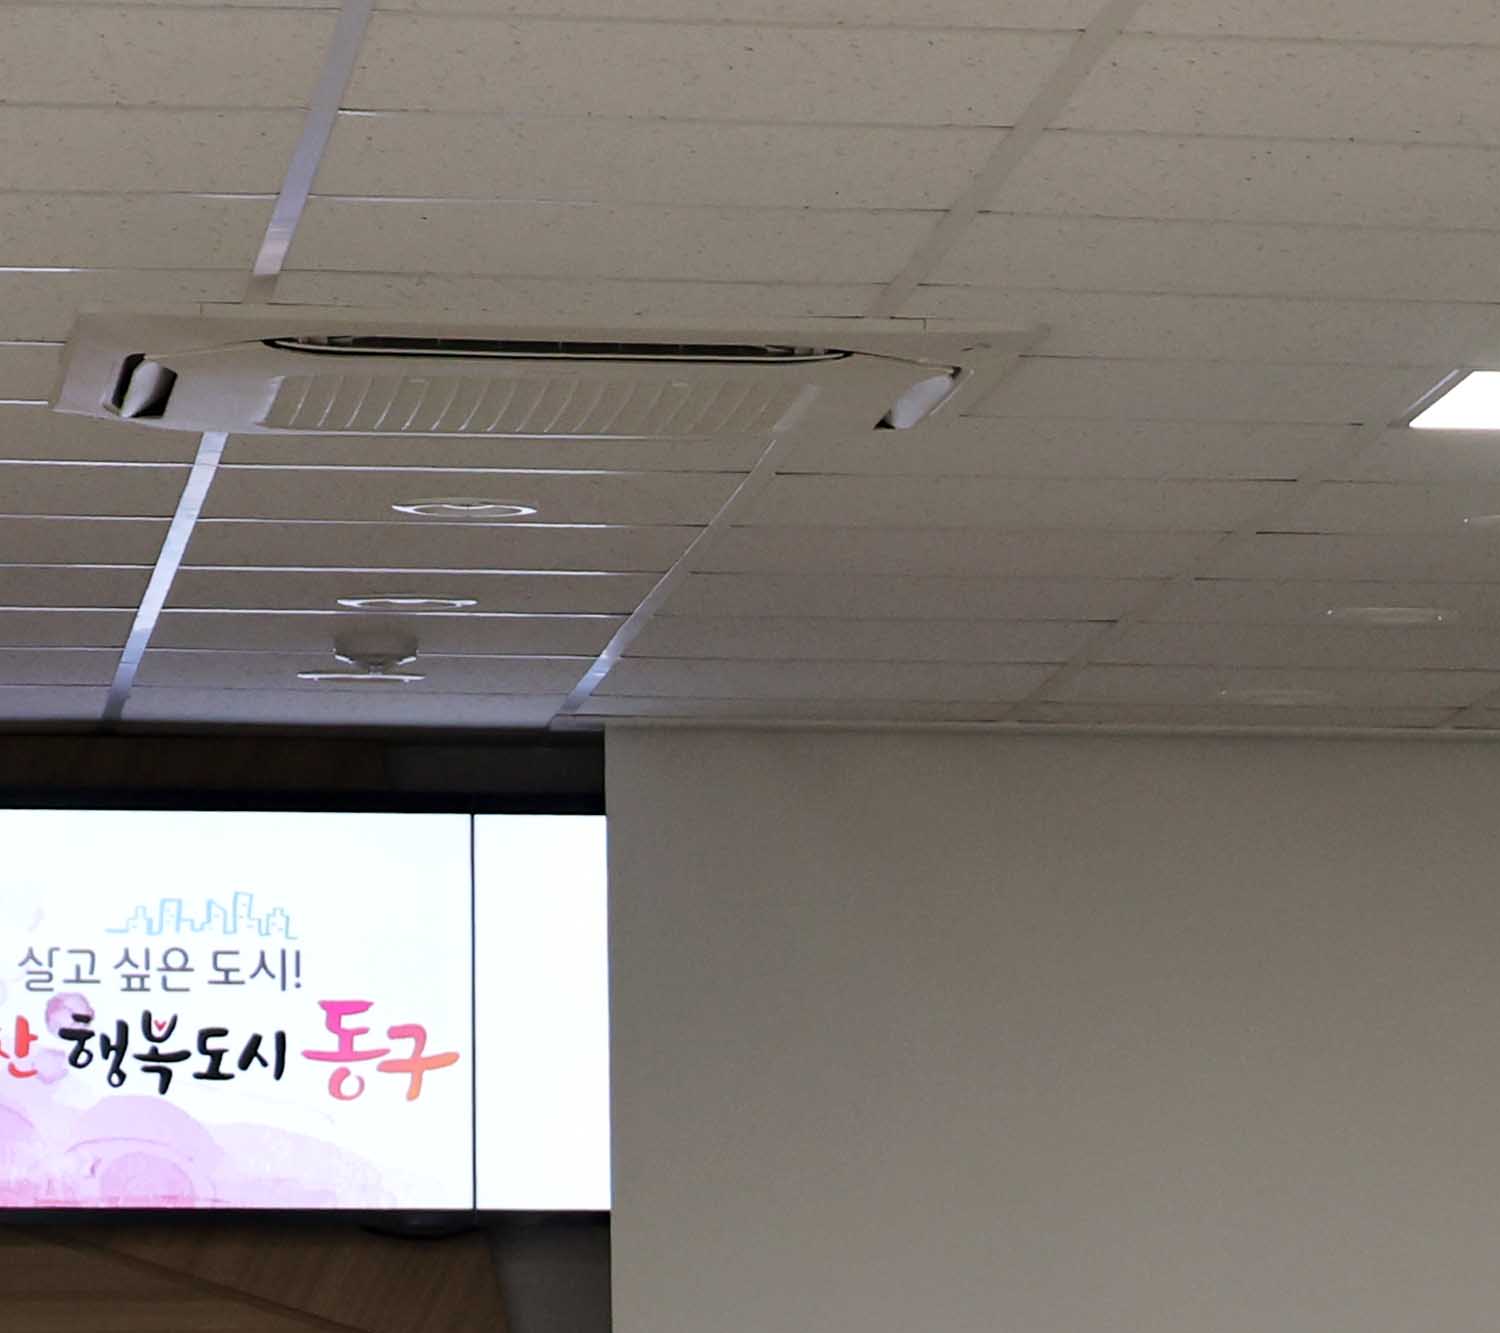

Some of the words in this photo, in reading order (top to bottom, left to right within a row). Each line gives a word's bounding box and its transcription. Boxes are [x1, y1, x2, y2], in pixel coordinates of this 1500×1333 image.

[17, 945, 101, 992] 살고
[113, 946, 195, 992] 싶은
[207, 947, 303, 992] 도시!
[58, 1009, 287, 1095] 행복도시
[301, 999, 460, 1102] 동구
